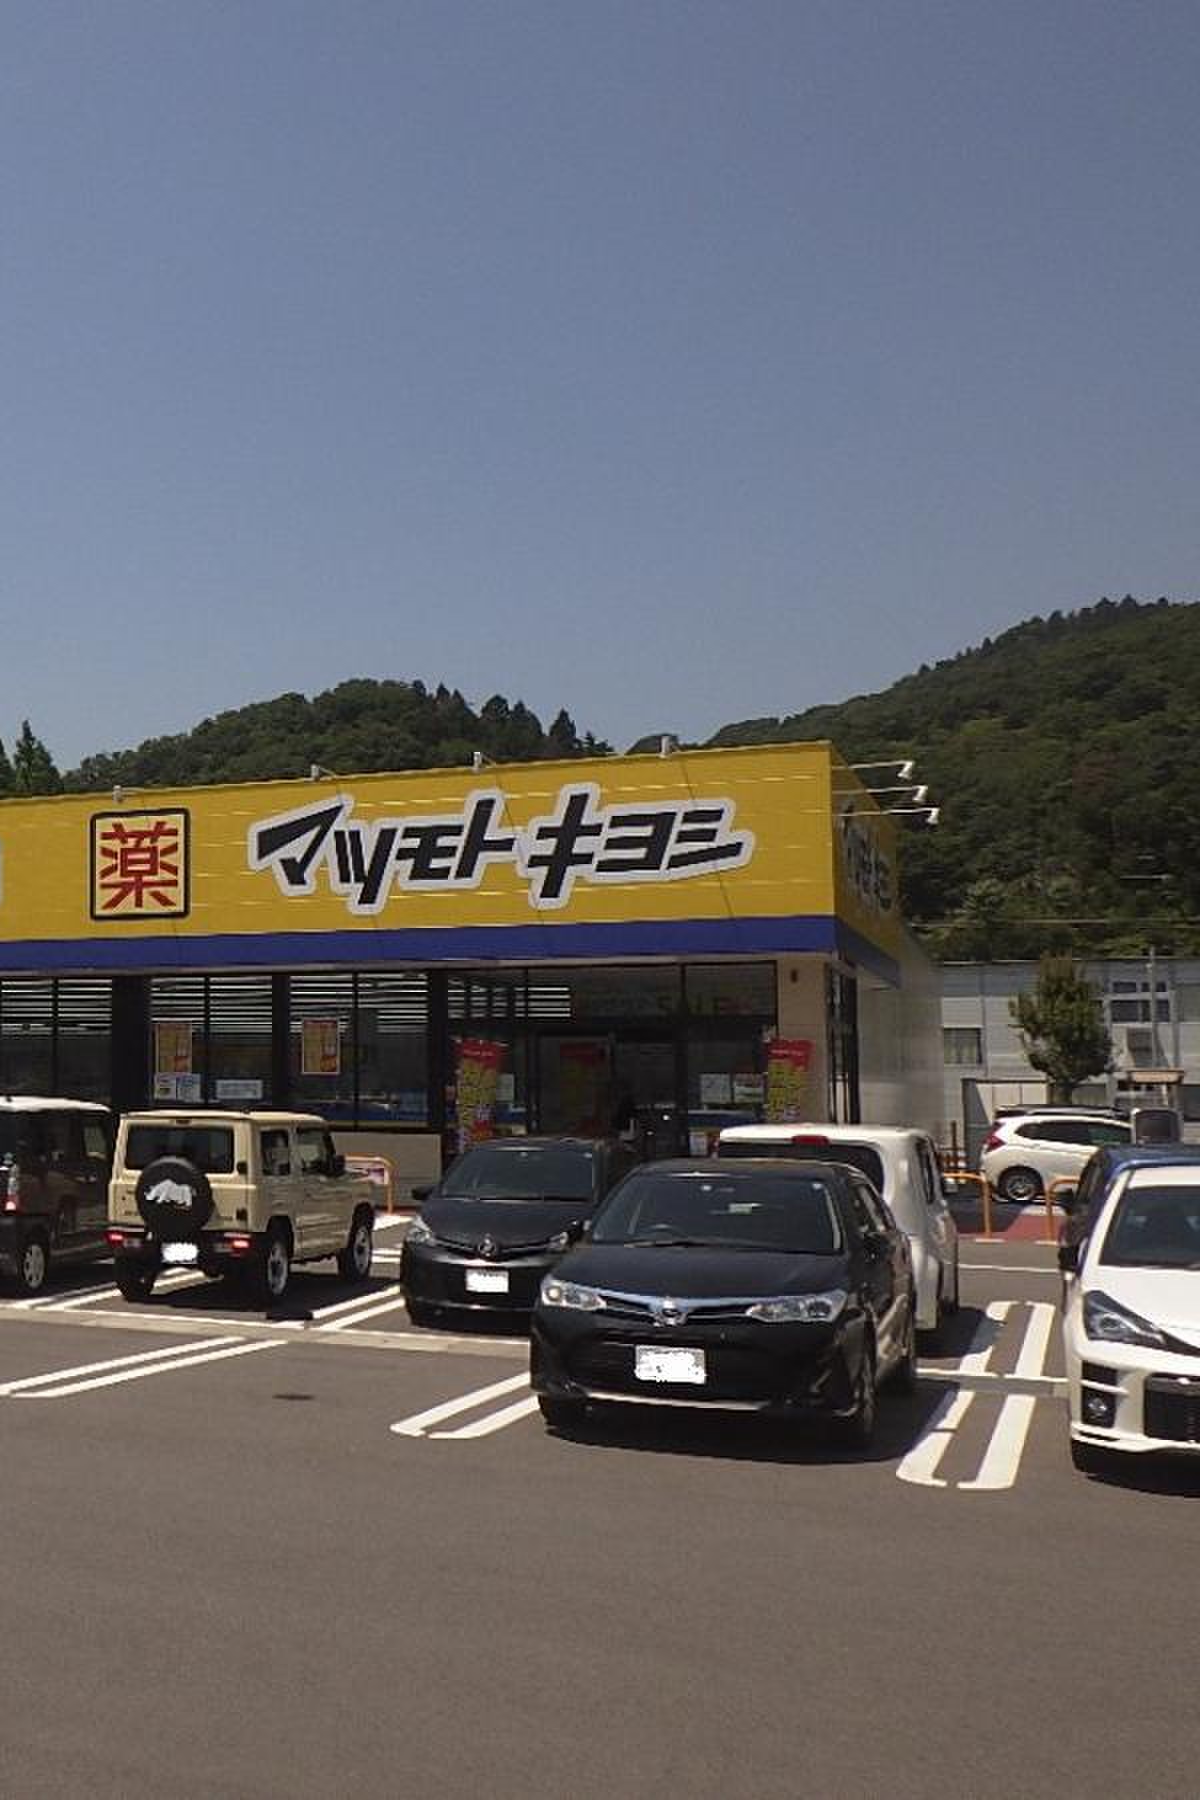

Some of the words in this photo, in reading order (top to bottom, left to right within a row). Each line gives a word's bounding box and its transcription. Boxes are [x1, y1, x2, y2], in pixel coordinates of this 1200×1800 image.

[100, 821, 179, 909] 薬
[257, 793, 744, 904] マツモトキヨシ
